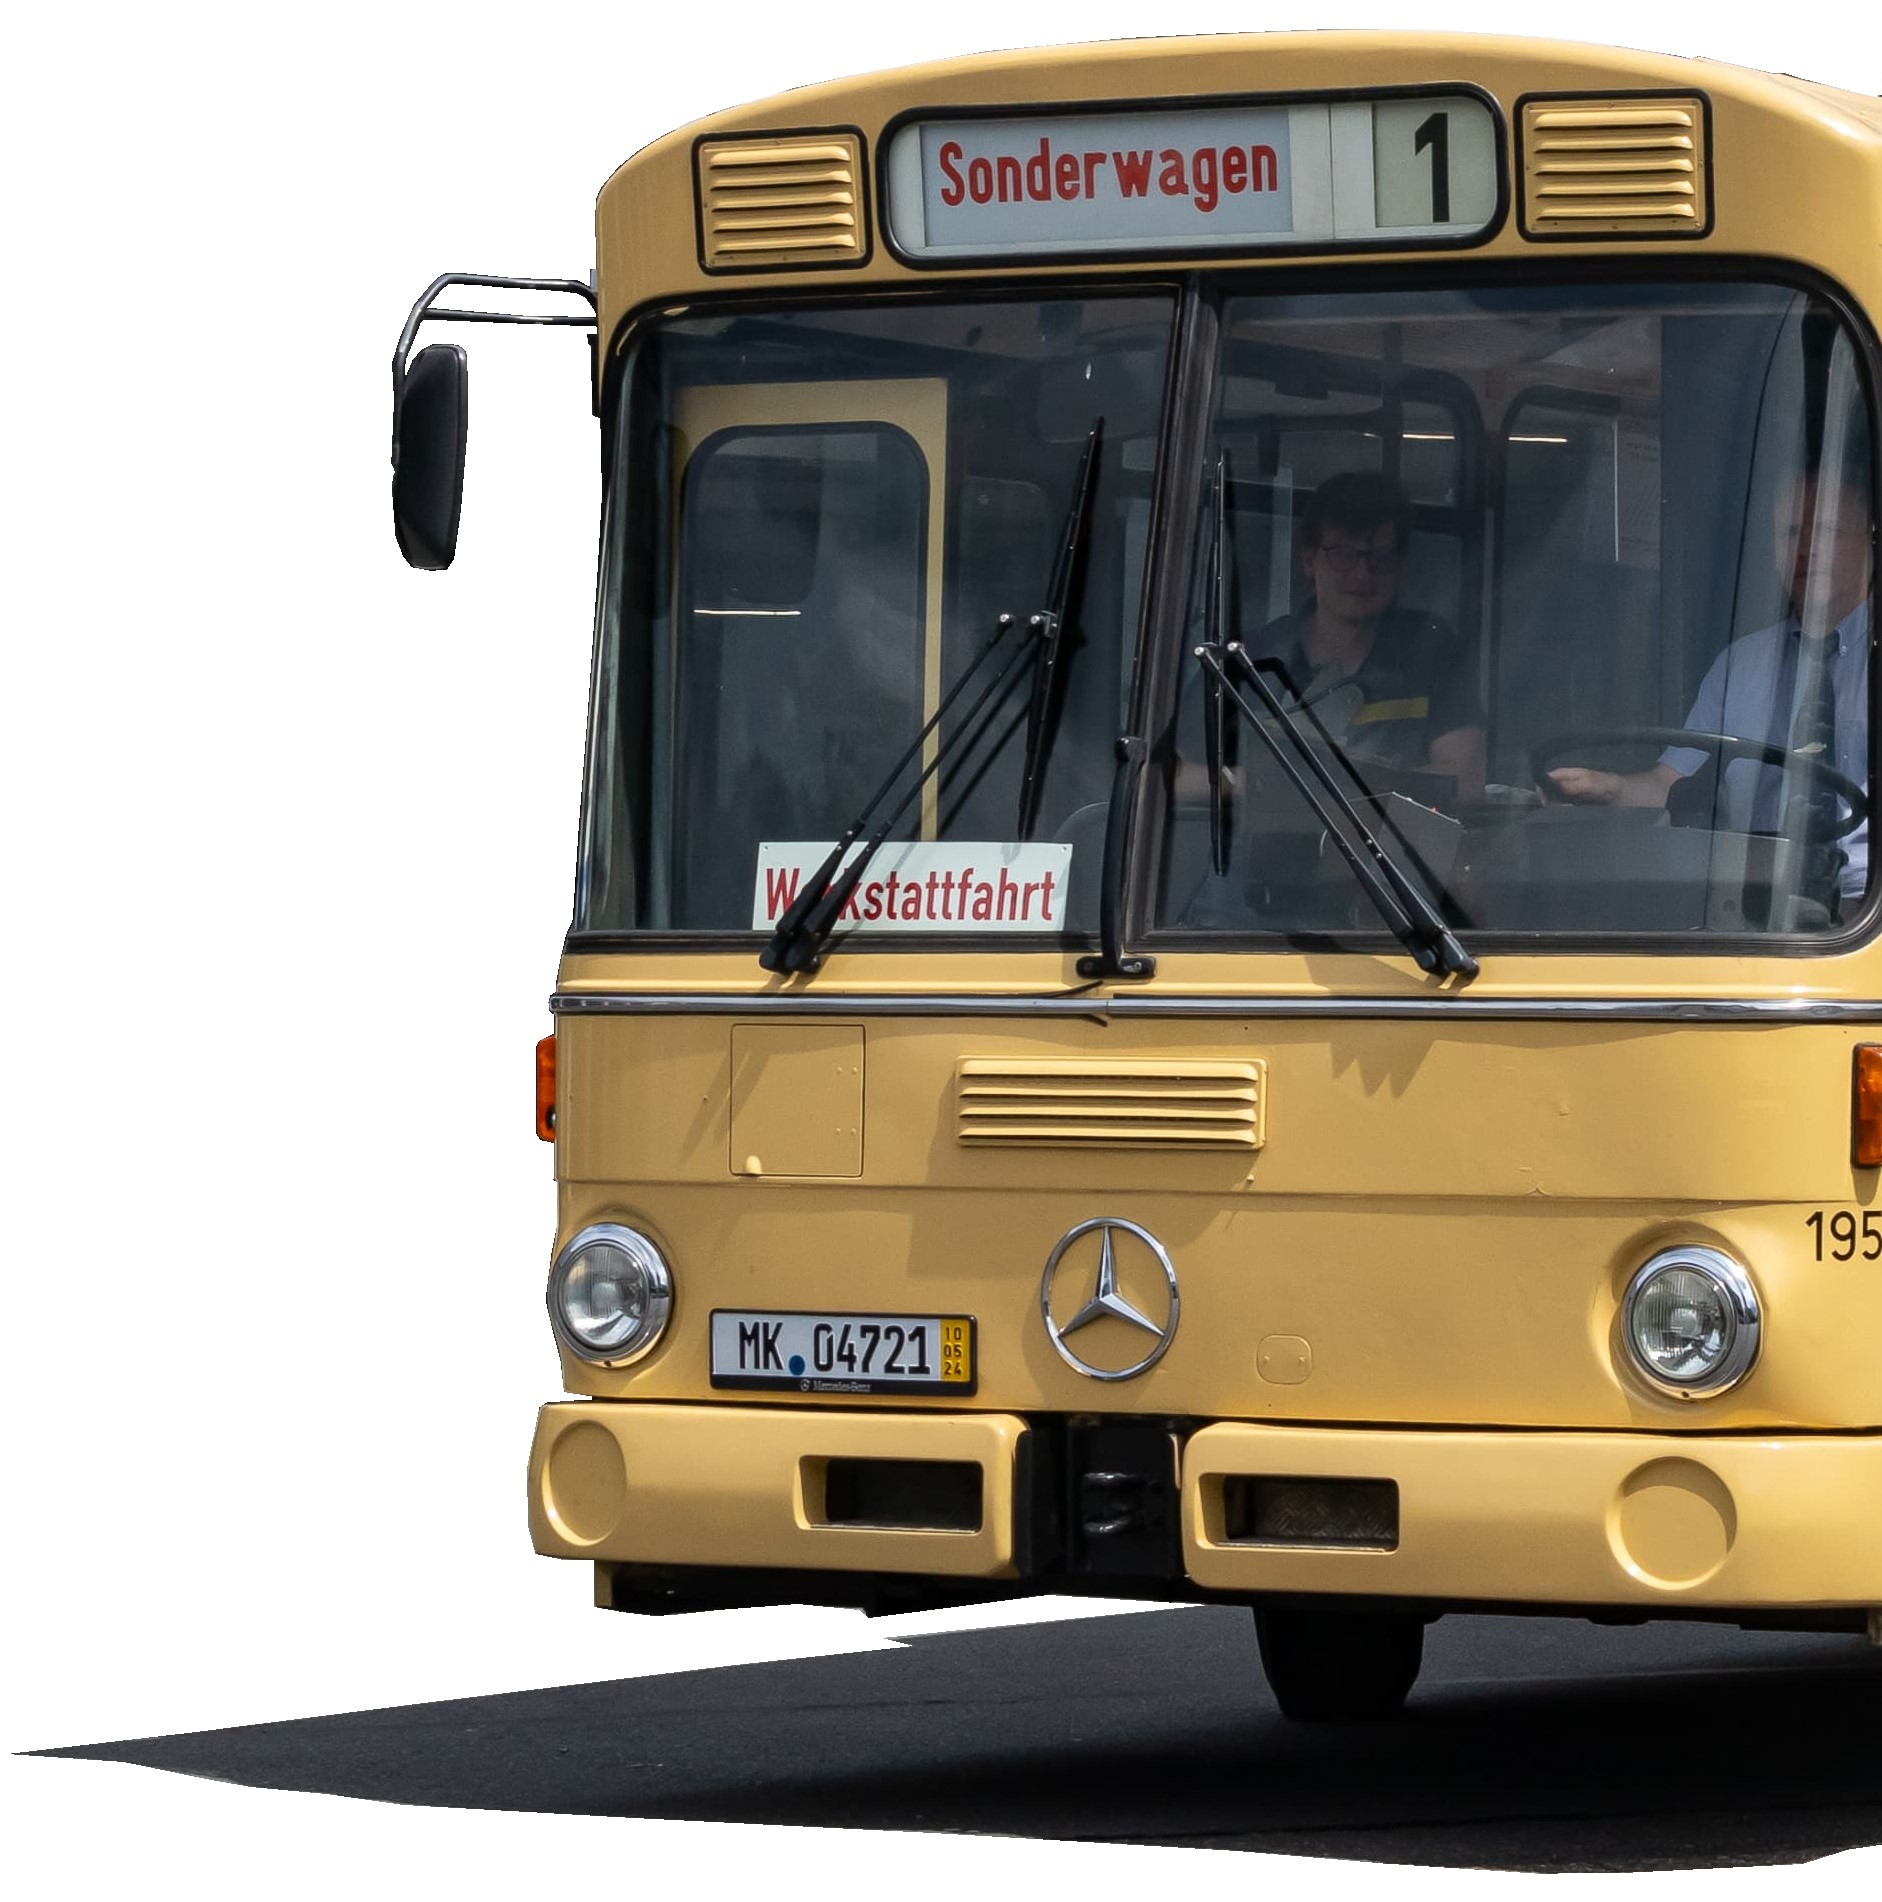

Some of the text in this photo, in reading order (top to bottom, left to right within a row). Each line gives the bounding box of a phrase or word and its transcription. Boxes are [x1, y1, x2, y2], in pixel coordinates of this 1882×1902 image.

[939, 138, 1278, 212] Sonderwagen
[1412, 112, 1449, 224] 1
[766, 868, 1056, 922] Wkstattfahrt
[738, 1321, 931, 1375] MK 04721
[943, 1344, 962, 1359] 05
[945, 1326, 962, 1341] 10
[943, 1361, 962, 1376] 24
